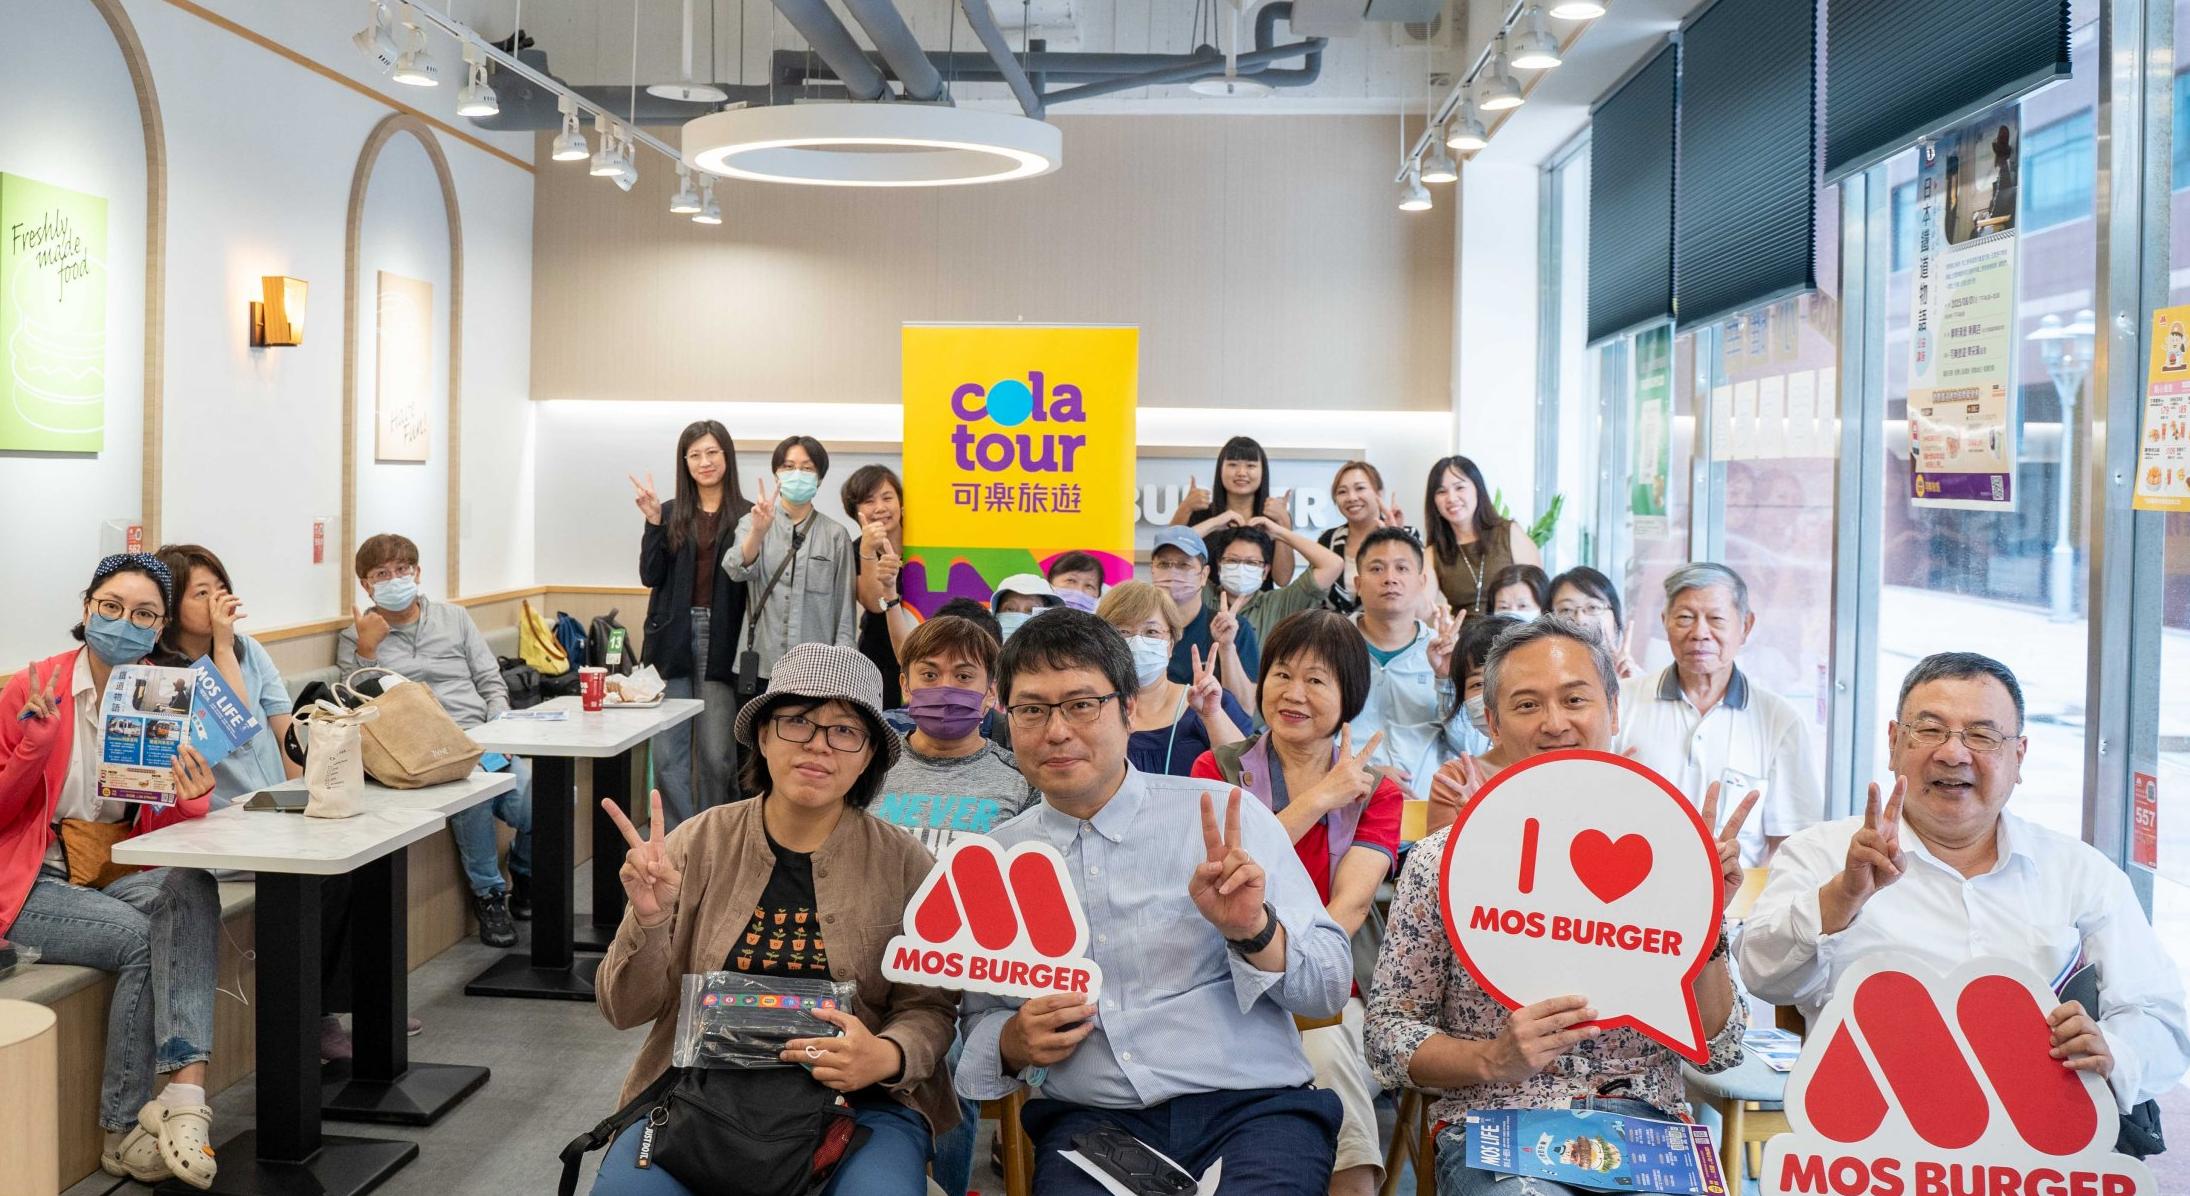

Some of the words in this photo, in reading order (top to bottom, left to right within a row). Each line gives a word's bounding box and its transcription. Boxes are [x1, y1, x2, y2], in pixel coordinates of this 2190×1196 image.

[12, 208, 69, 256] Freshly
[36, 227, 81, 269] made
[57, 247, 89, 303] food
[950, 370, 1087, 428] cola
[951, 424, 1087, 473] tour
[609, 635, 623, 650] 13
[196, 665, 222, 698] MOS
[215, 695, 245, 729] LIFE
[880, 791, 1001, 834] NEVER
[2135, 807, 2156, 828] 557
[1518, 817, 1540, 895] I
[1469, 905, 1547, 939] MOS
[1551, 915, 1684, 957] BURGER
[892, 946, 965, 978] MOS
[968, 955, 1092, 994] BURGER
[1480, 1124, 1500, 1147] LIFE
[1480, 1146, 1501, 1167] MOS
[1779, 1153, 1905, 1196] MOS
